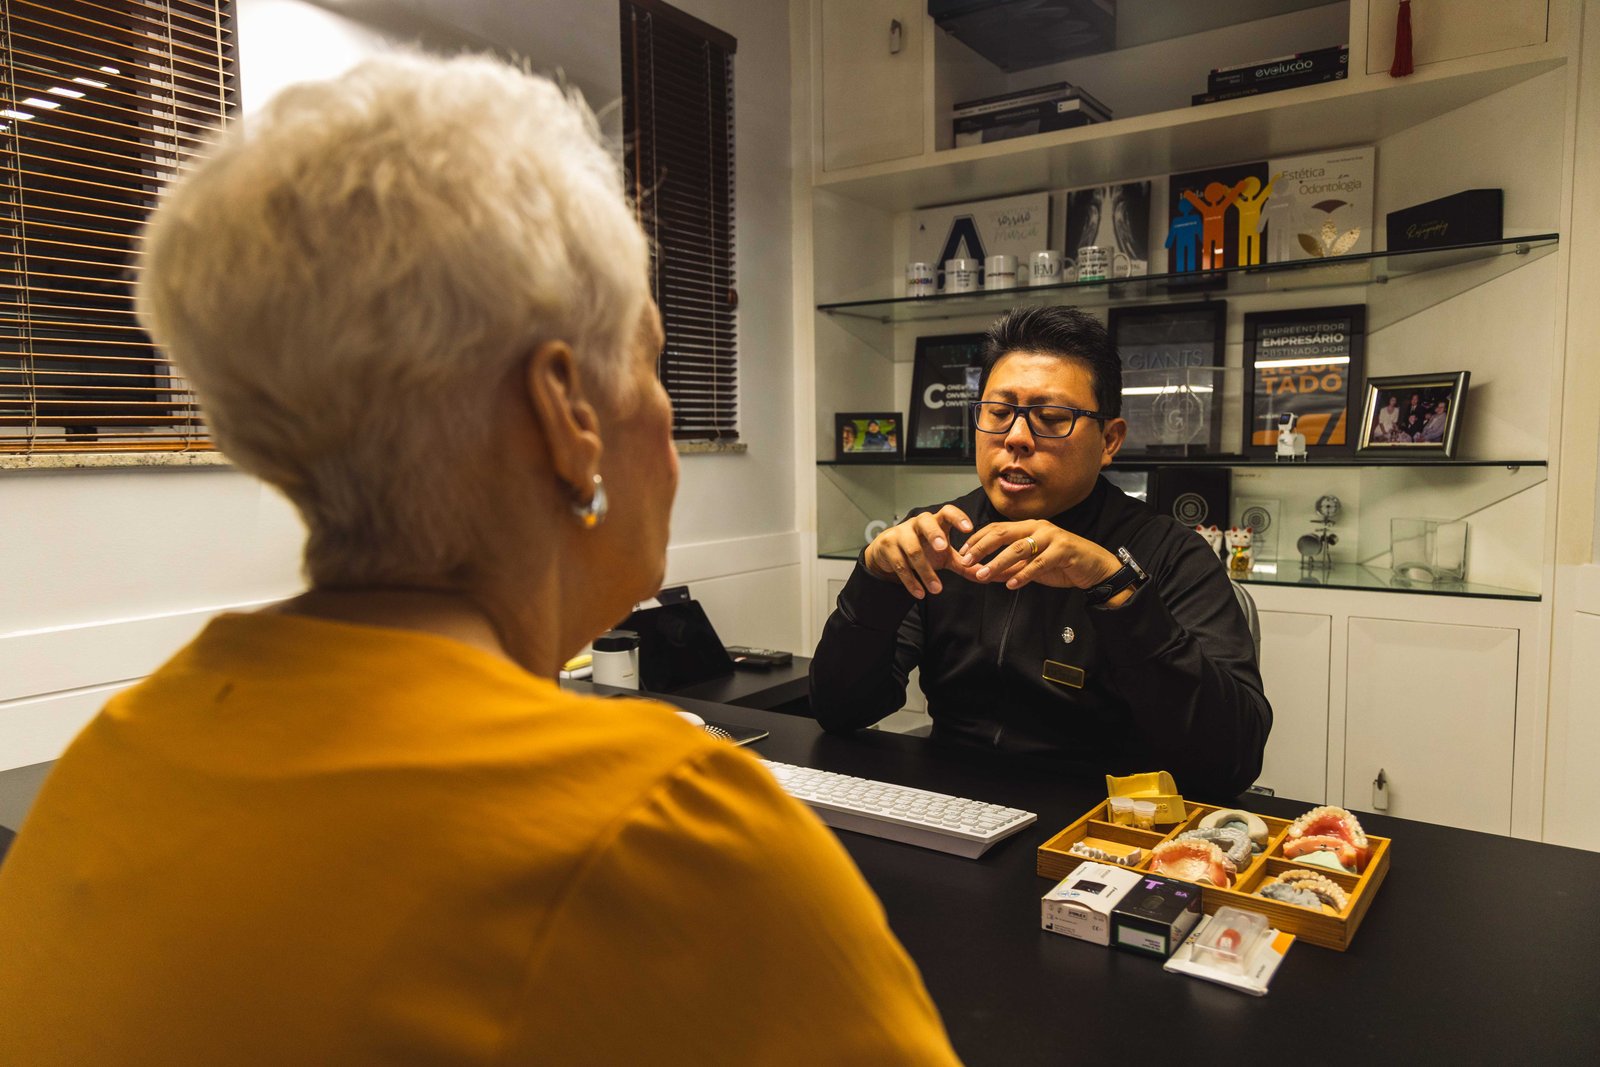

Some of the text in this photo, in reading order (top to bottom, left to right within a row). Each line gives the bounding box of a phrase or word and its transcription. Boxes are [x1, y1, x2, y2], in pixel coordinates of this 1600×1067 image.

[1281, 167, 1325, 180] Estética
[1299, 178, 1361, 195] Odontologia
[1262, 323, 1345, 336] EMPREENDEDOR
[1262, 331, 1344, 347] EMPRESÁRIO
[1262, 345, 1344, 357] OBSTINADO POR
[1128, 350, 1203, 369] GIANTS
[1261, 373, 1343, 395] TADO
